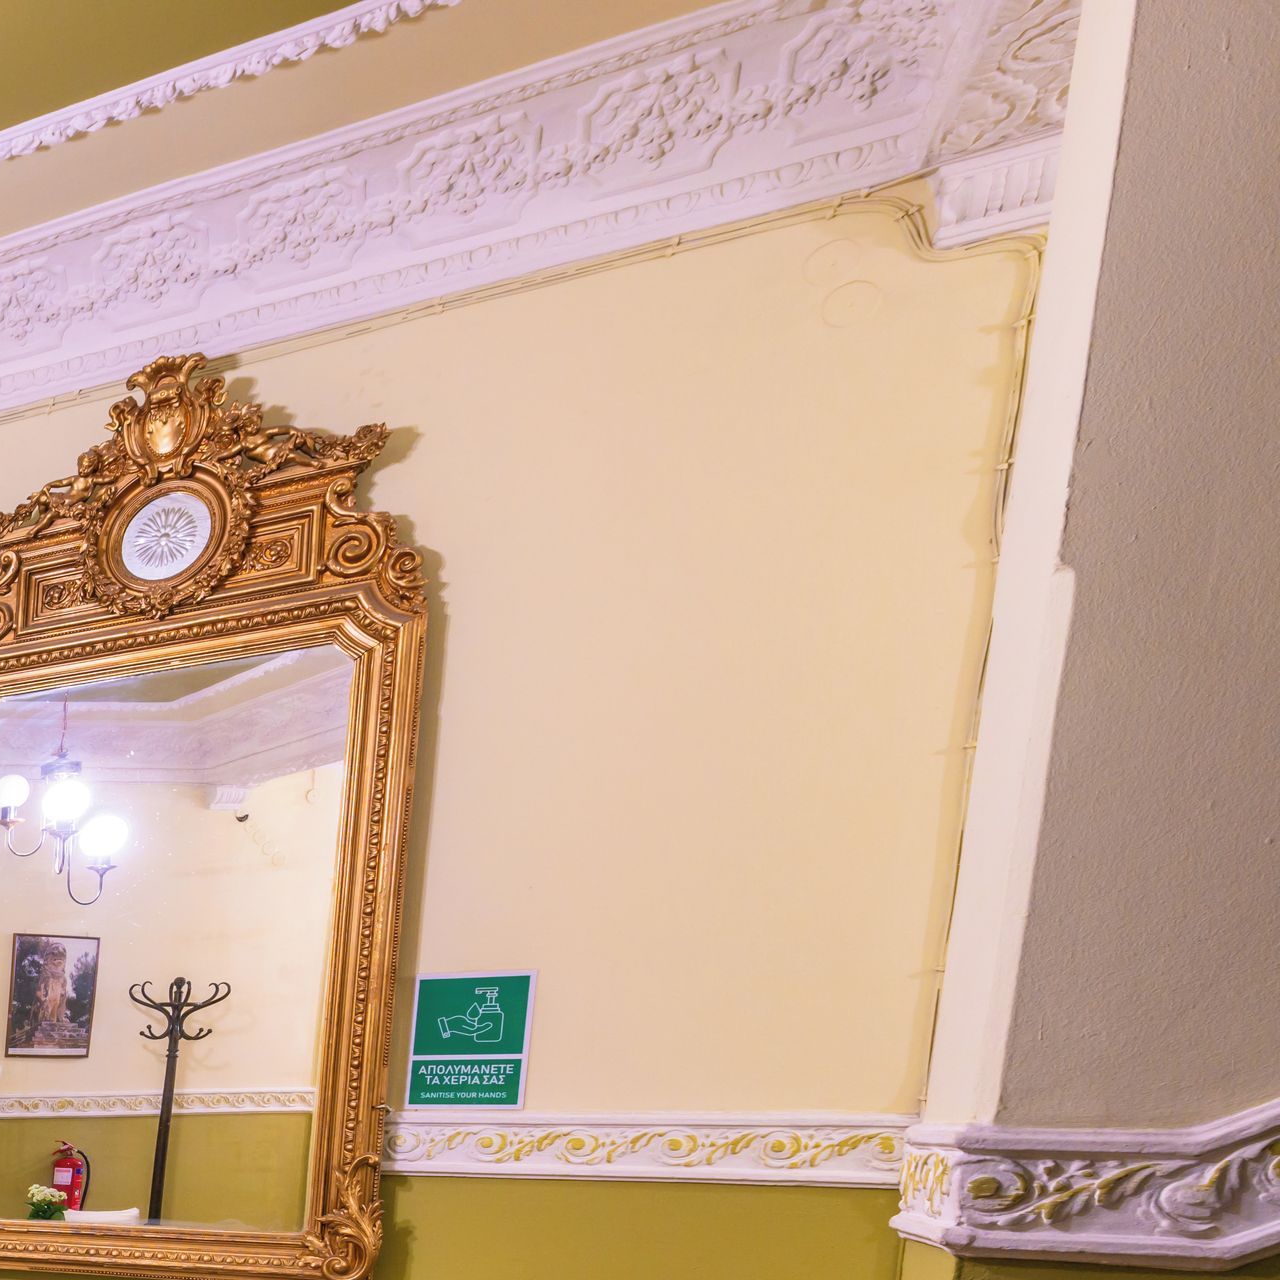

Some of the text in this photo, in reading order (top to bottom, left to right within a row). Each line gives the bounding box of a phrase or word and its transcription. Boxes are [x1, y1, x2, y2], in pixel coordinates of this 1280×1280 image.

[418, 1064, 515, 1075] ΑΠΟΛΥΜΑΝΕΤΕ
[425, 1075, 506, 1085] ΤΑ ΧΕΡΙΑ ΣΑΣ
